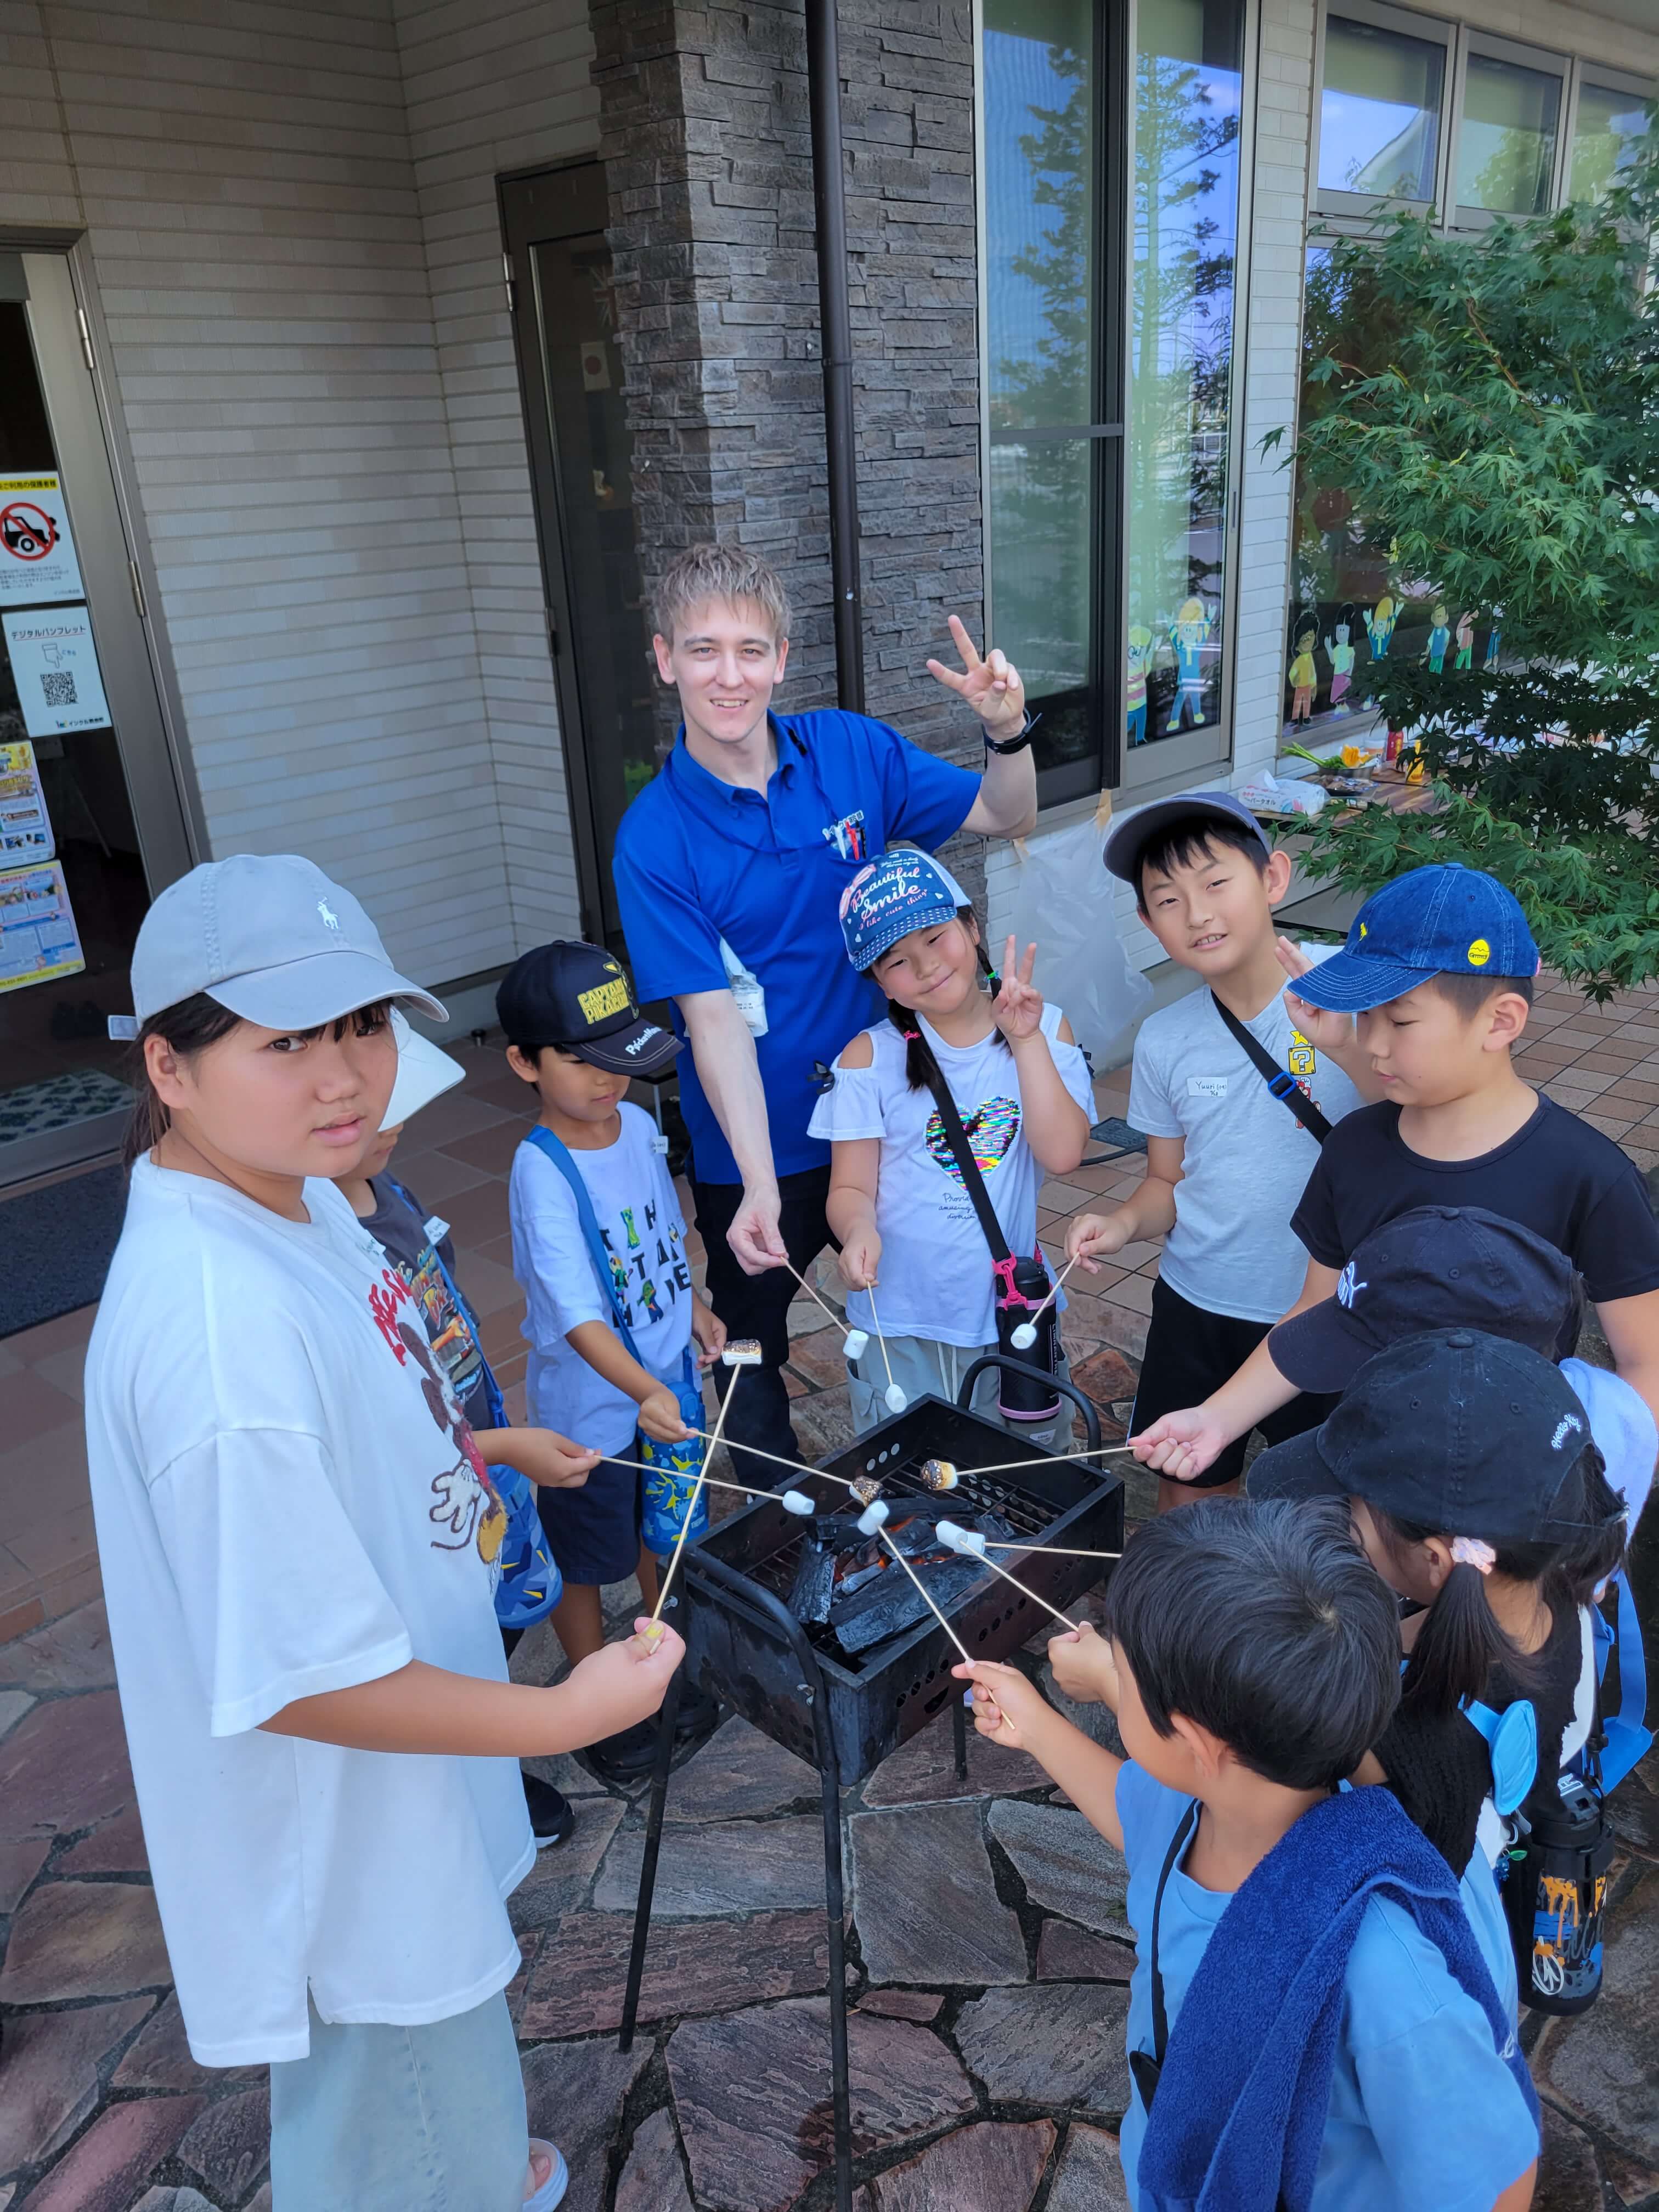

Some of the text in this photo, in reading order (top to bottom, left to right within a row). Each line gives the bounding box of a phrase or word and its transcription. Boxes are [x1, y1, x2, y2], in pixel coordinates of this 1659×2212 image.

[850, 867, 920, 913] Beautiful
[861, 880, 920, 922] Smile
[867, 917, 882, 928] like
[885, 906, 904, 917] cute
